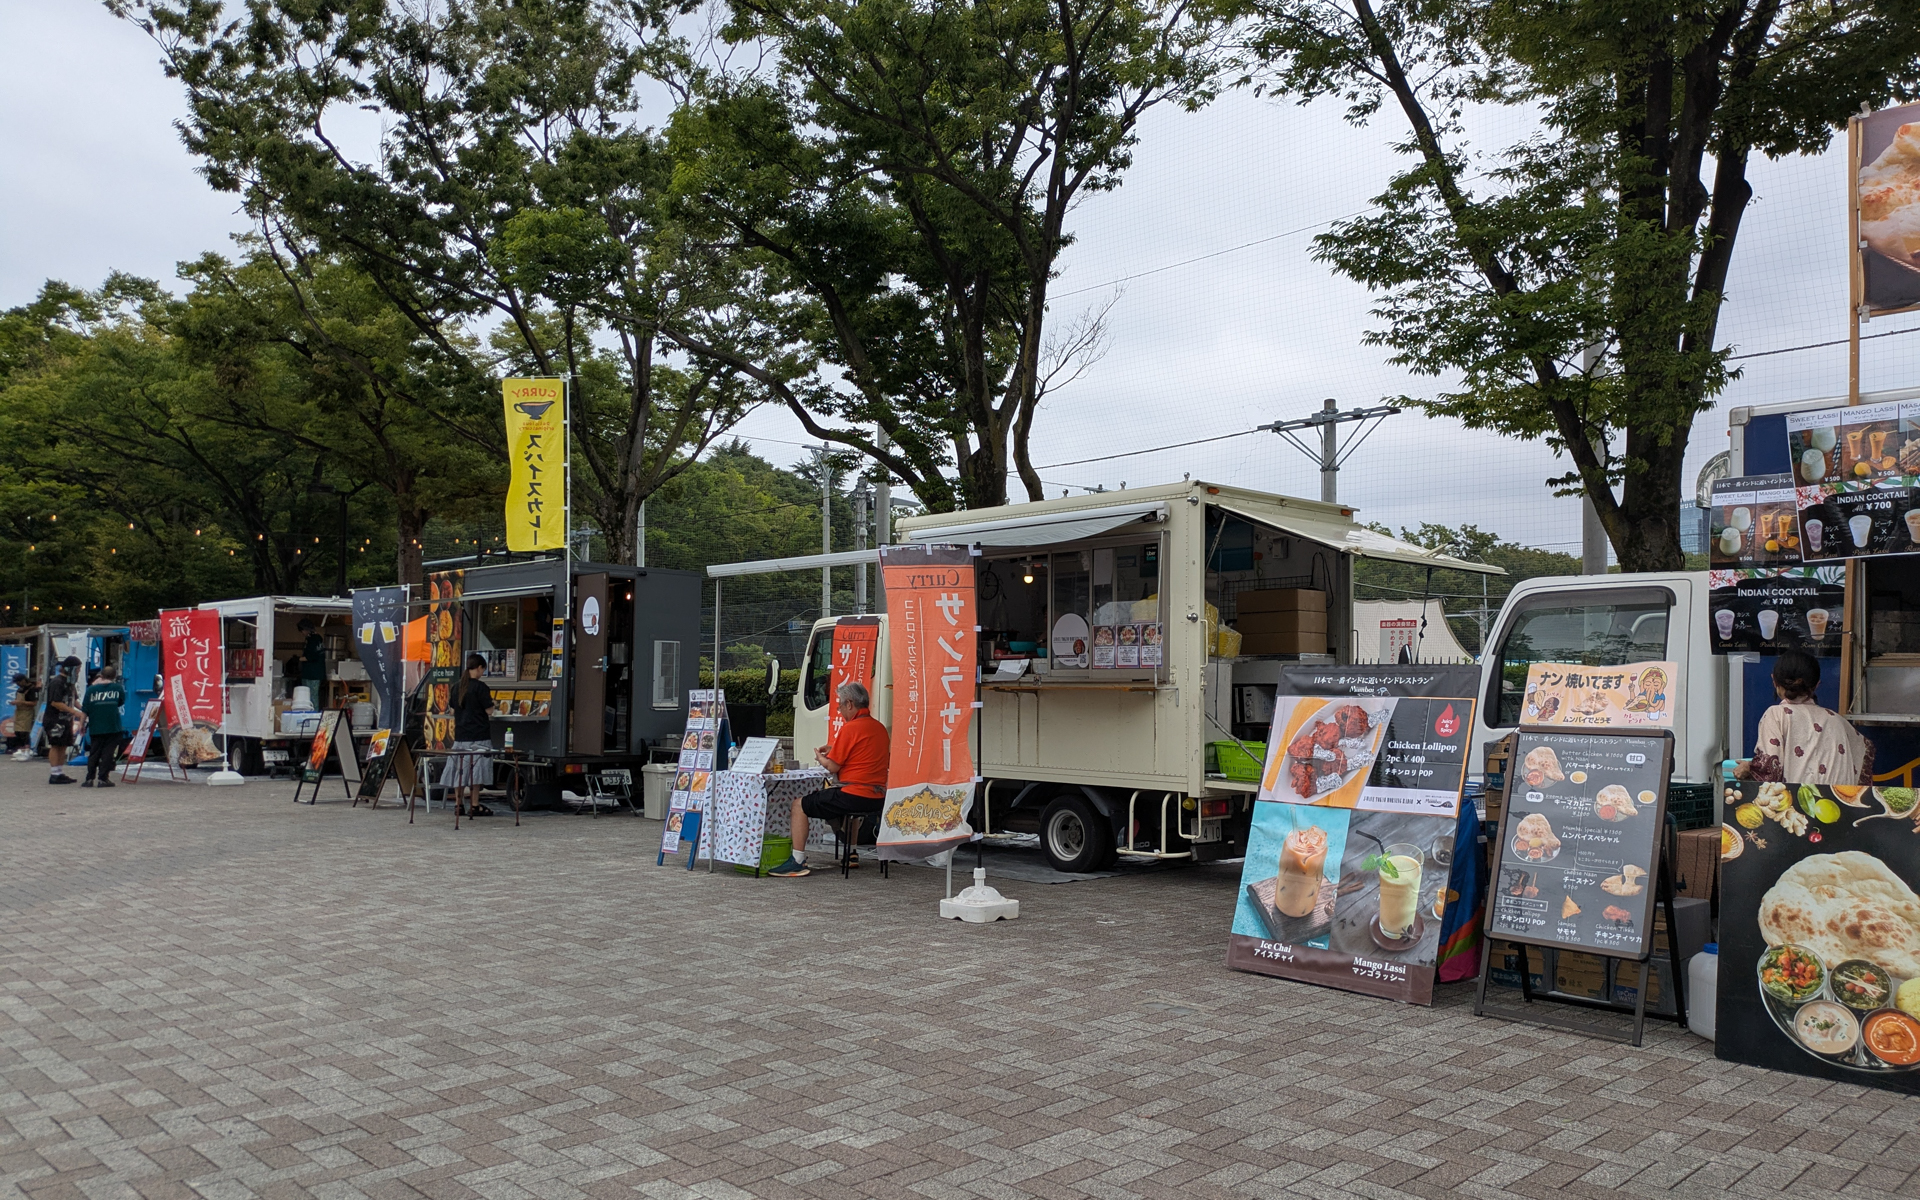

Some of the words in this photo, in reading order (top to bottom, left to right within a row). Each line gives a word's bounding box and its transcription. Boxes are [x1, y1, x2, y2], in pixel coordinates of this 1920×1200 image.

[1843, 409, 1872, 417] MANGO
[1874, 405, 1897, 413] LASSI
[1789, 415, 1816, 424] SWEET
[1817, 412, 1839, 421] LASSI
[1837, 495, 1865, 504] INDIAN
[1866, 490, 1909, 501] COCKTAIL
[1866, 500, 1892, 511] ¥700
[1737, 588, 1770, 597] INDIAN
[1771, 587, 1819, 597] COCKTAIL
[1539, 671, 1563, 686] ナン
[1565, 672, 1625, 690] 焼いてます
[1349, 685, 1375, 694] Mumbai
[1562, 715, 1612, 725] ムンバイでどうぞ
[1387, 740, 1421, 750] Chicken
[1422, 742, 1458, 754] Lollipop
[1561, 749, 1581, 757] Butter
[1385, 754, 1401, 764] 2pc
[1629, 754, 1643, 762] 甘口
[1384, 768, 1417, 777] チキンロリ
[1418, 769, 1434, 777] POP
[1565, 762, 1603, 771] バターチキン
[1554, 799, 1592, 807] キーマカレー
[1561, 831, 1620, 844] ムンバイスペシャル
[1500, 914, 1531, 925] チキンロリ
[1532, 918, 1546, 926] POP
[1556, 927, 1577, 936] サモサ
[1594, 930, 1642, 943] チキンティッカ
[1260, 940, 1273, 950] Ice
[1273, 942, 1292, 953] Chai
[1253, 948, 1294, 963] アイスチャイ
[1353, 956, 1383, 971] Mango
[1384, 960, 1407, 974] Lassi
[1352, 967, 1406, 982] マンゴラッシー
